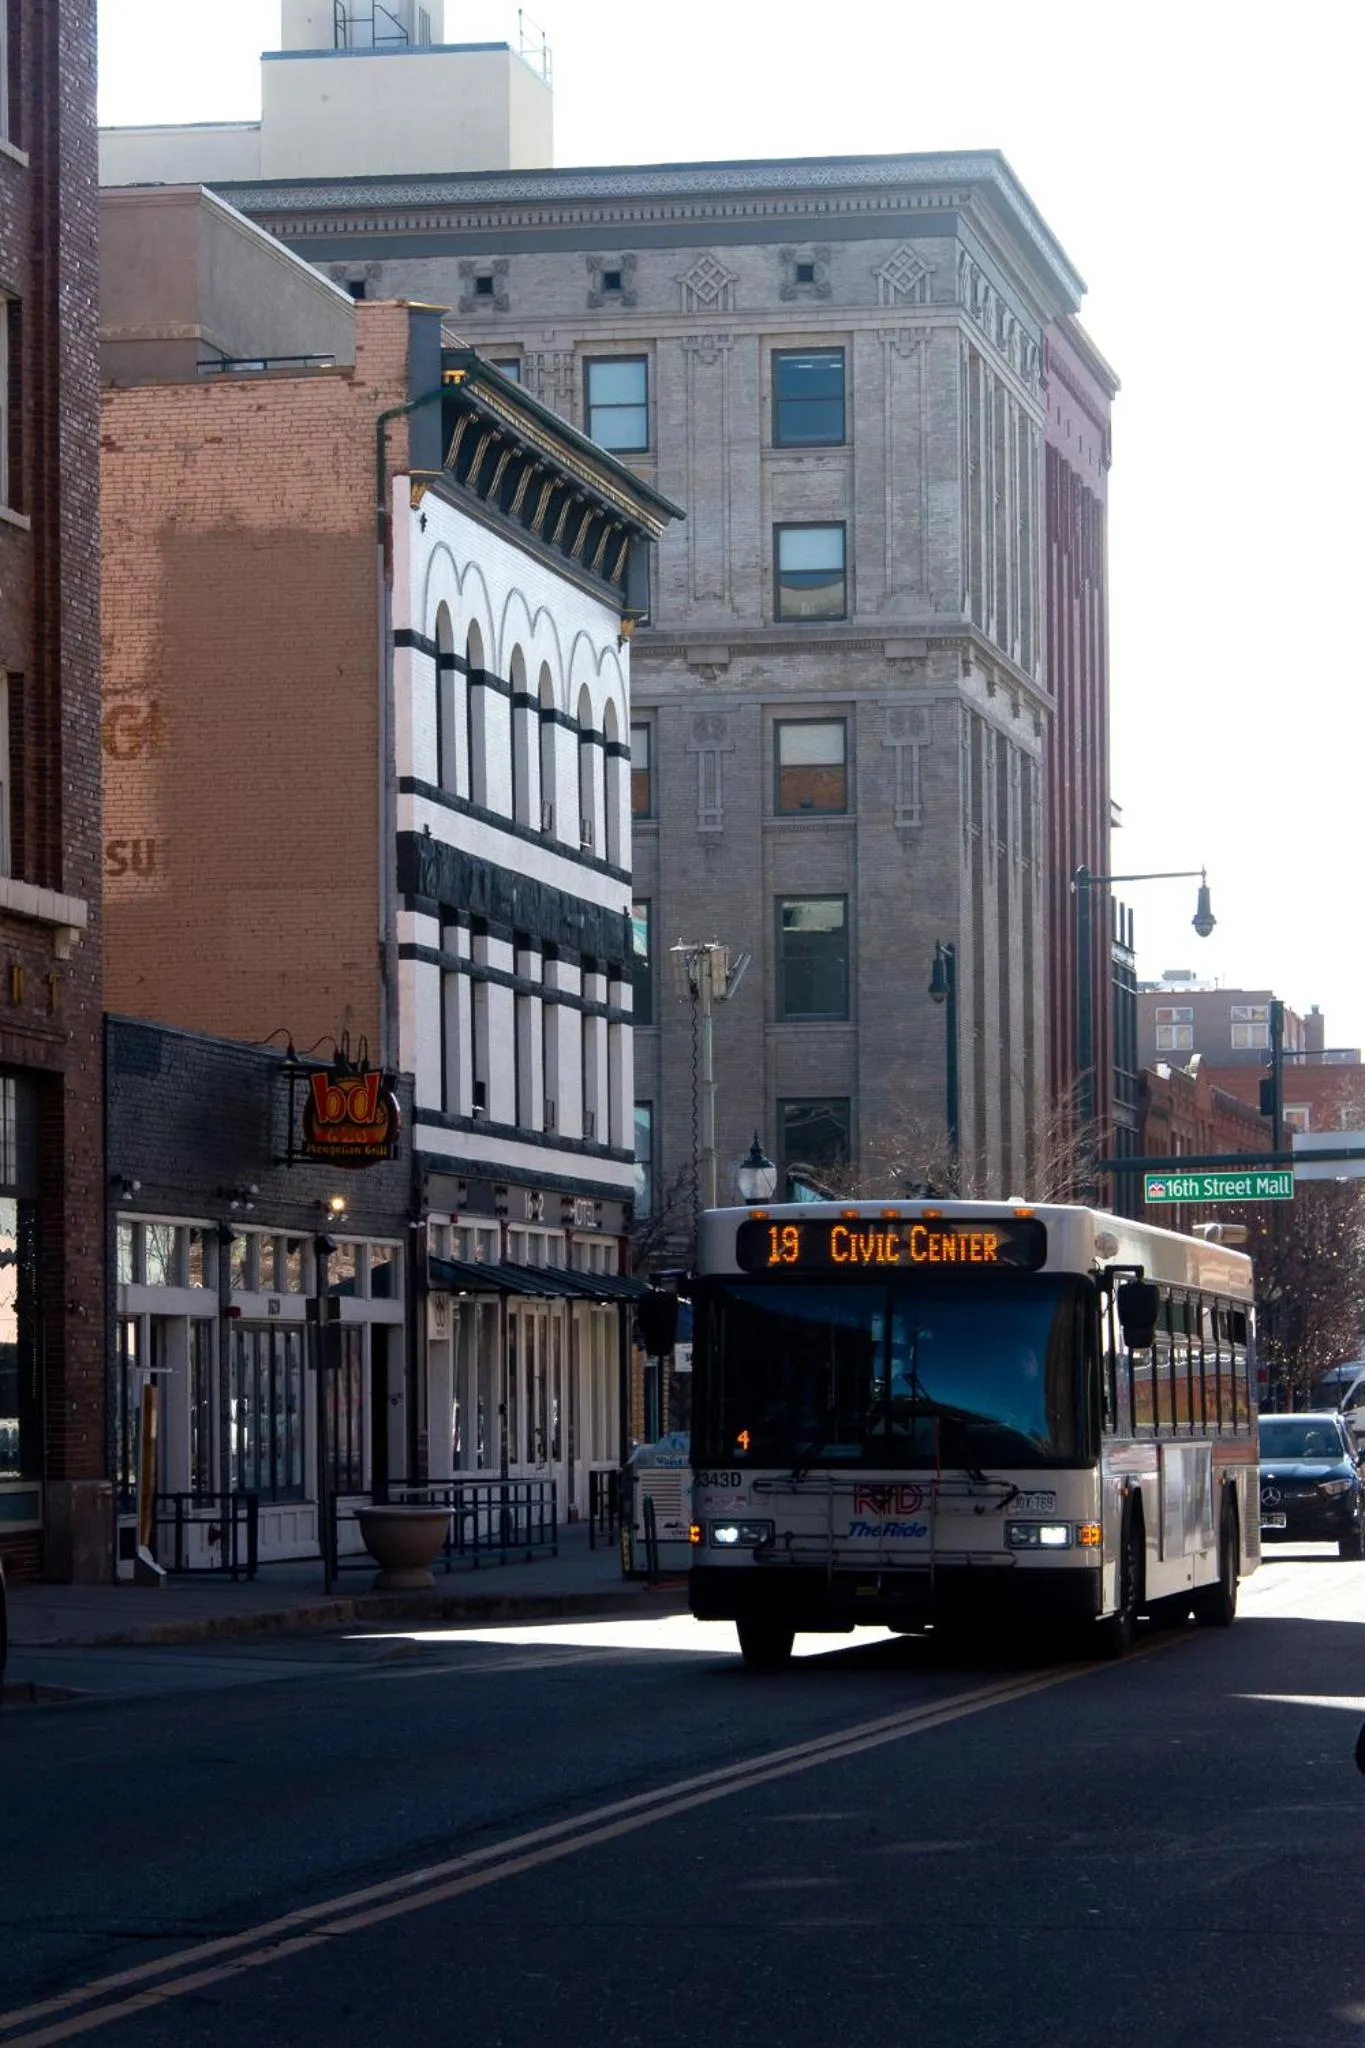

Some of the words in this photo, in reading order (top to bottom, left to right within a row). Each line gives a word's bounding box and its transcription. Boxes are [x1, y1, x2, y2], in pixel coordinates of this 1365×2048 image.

[365, 1144, 388, 1156] Grill
[1166, 1180, 1199, 1196] 16th
[1203, 1178, 1251, 1195] Street
[1256, 1176, 1289, 1194] Mall
[768, 1225, 799, 1263] 19
[737, 1430, 750, 1451] 4
